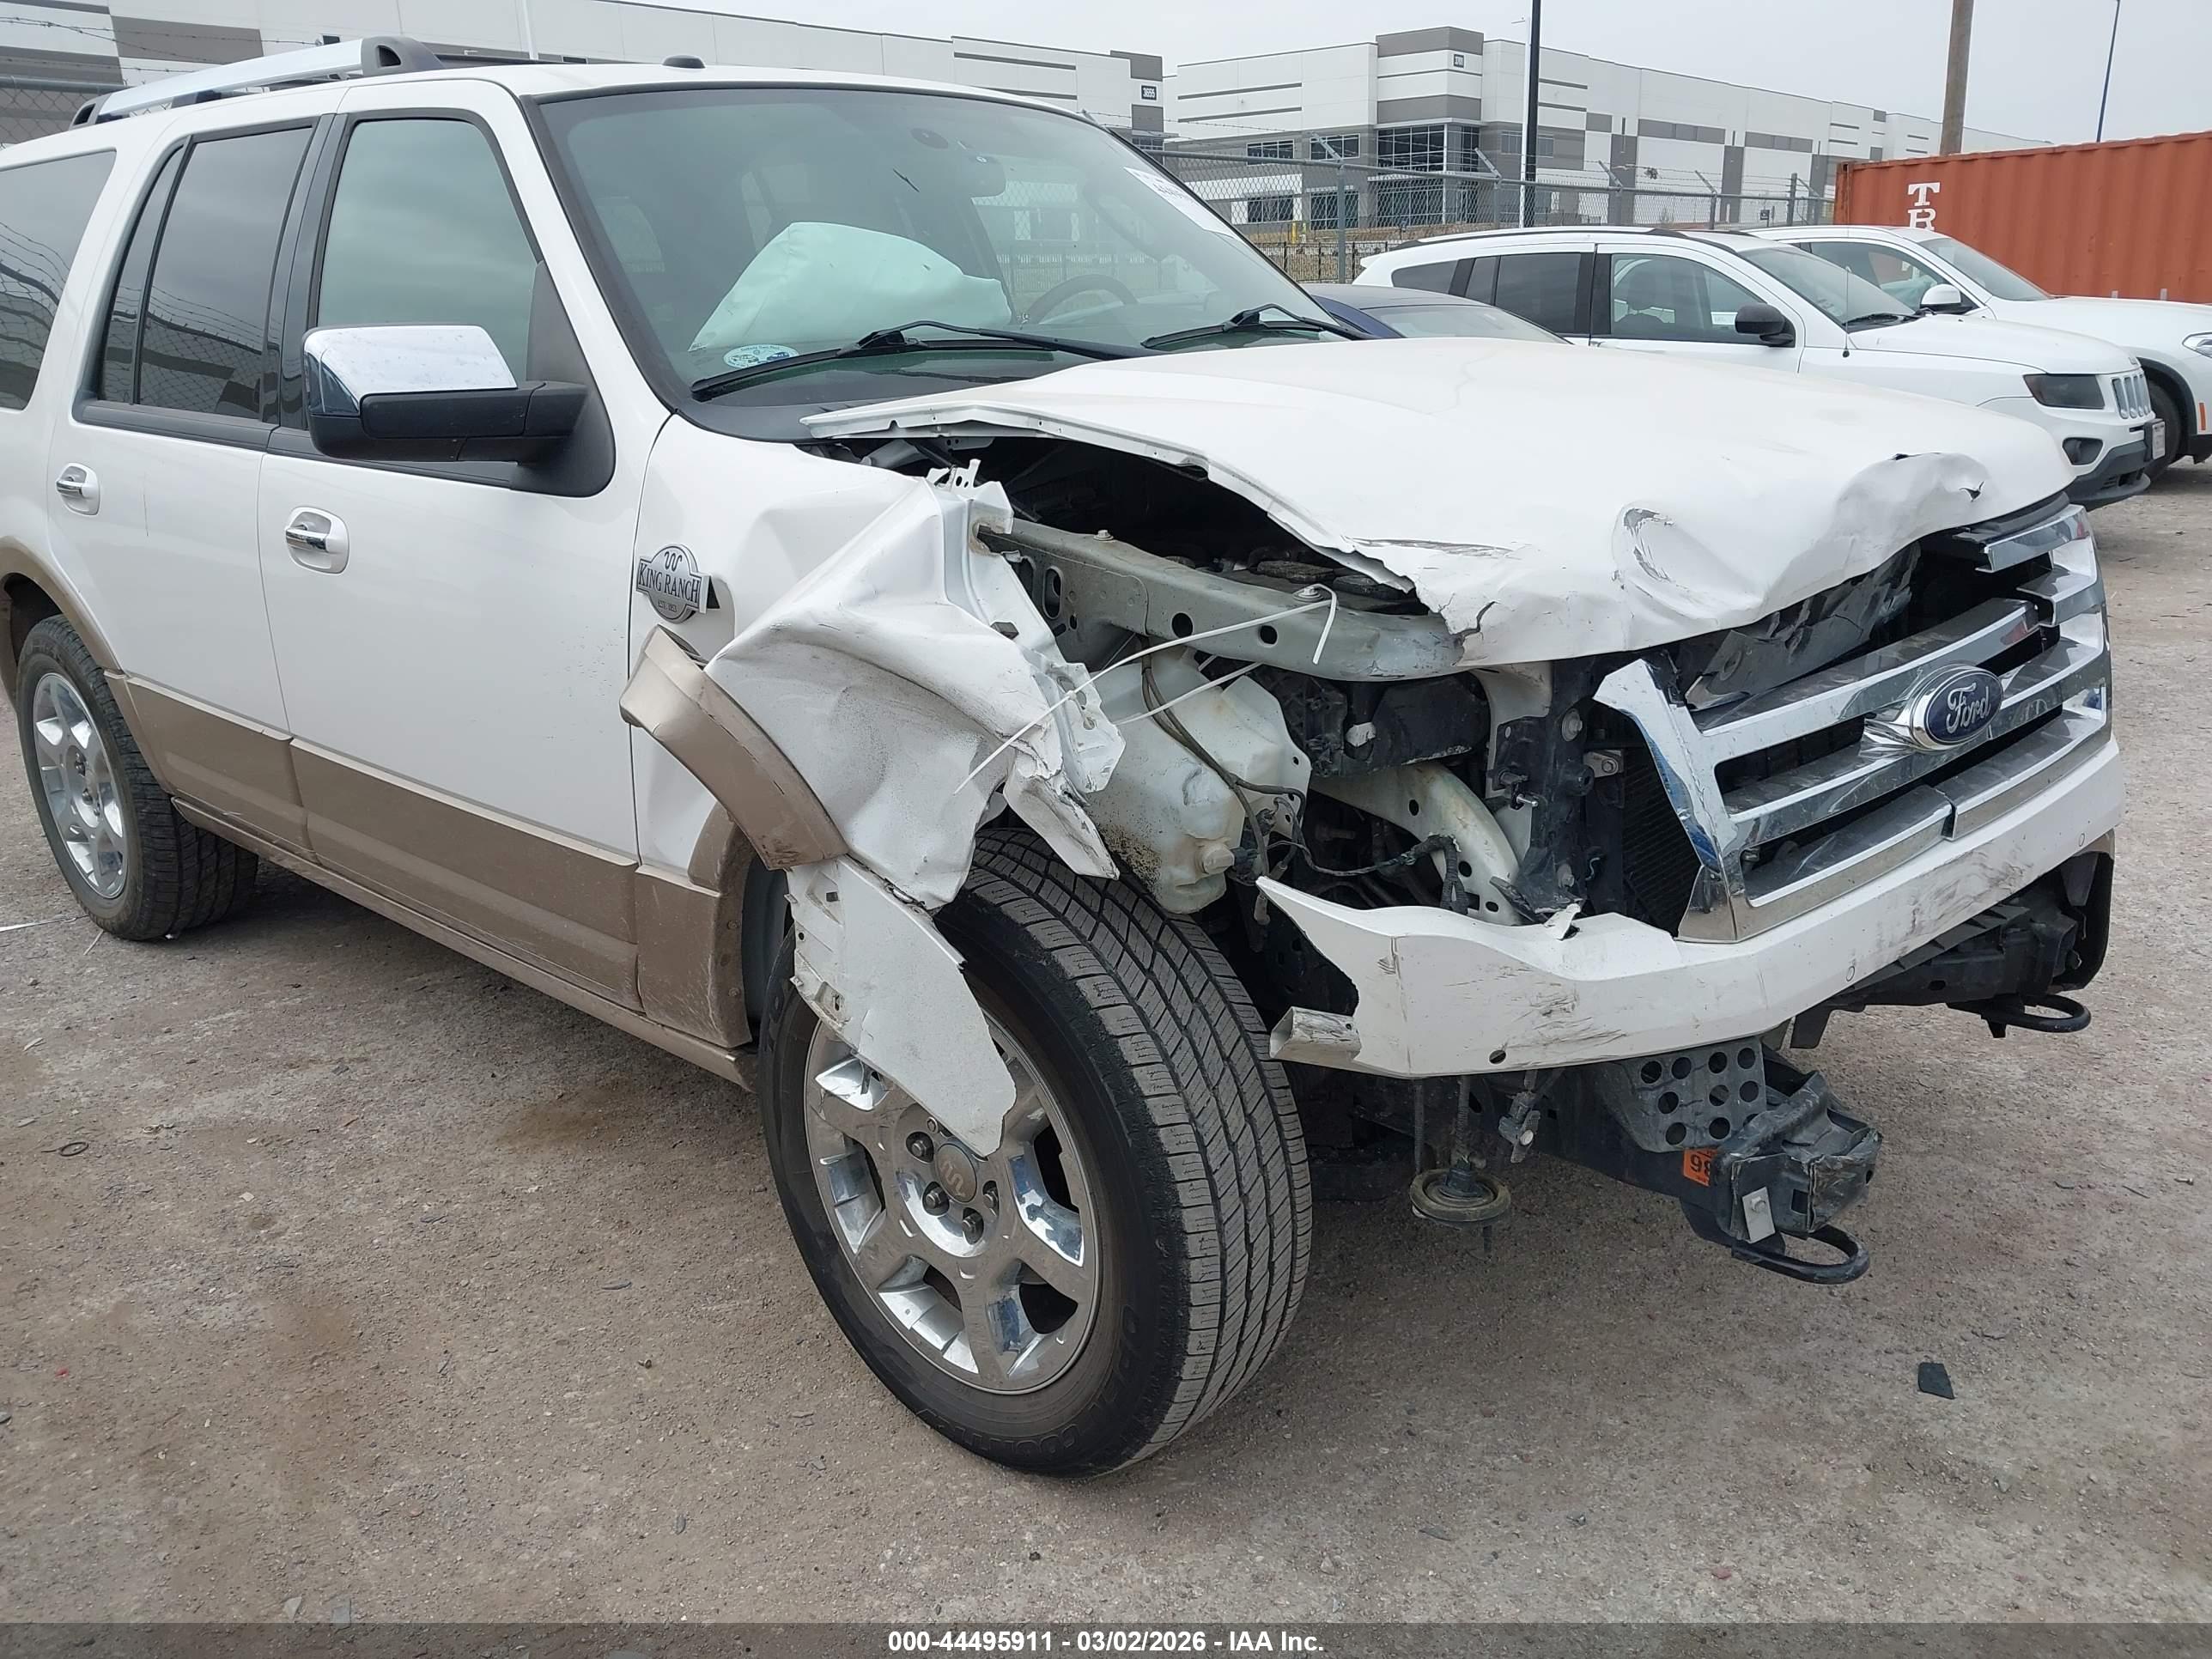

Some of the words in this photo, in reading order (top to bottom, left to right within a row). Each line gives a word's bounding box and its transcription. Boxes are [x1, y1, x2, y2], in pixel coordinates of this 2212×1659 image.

[638, 562, 663, 592] KING
[664, 574, 700, 604] RANCH
[1946, 682, 1991, 734] Ford
